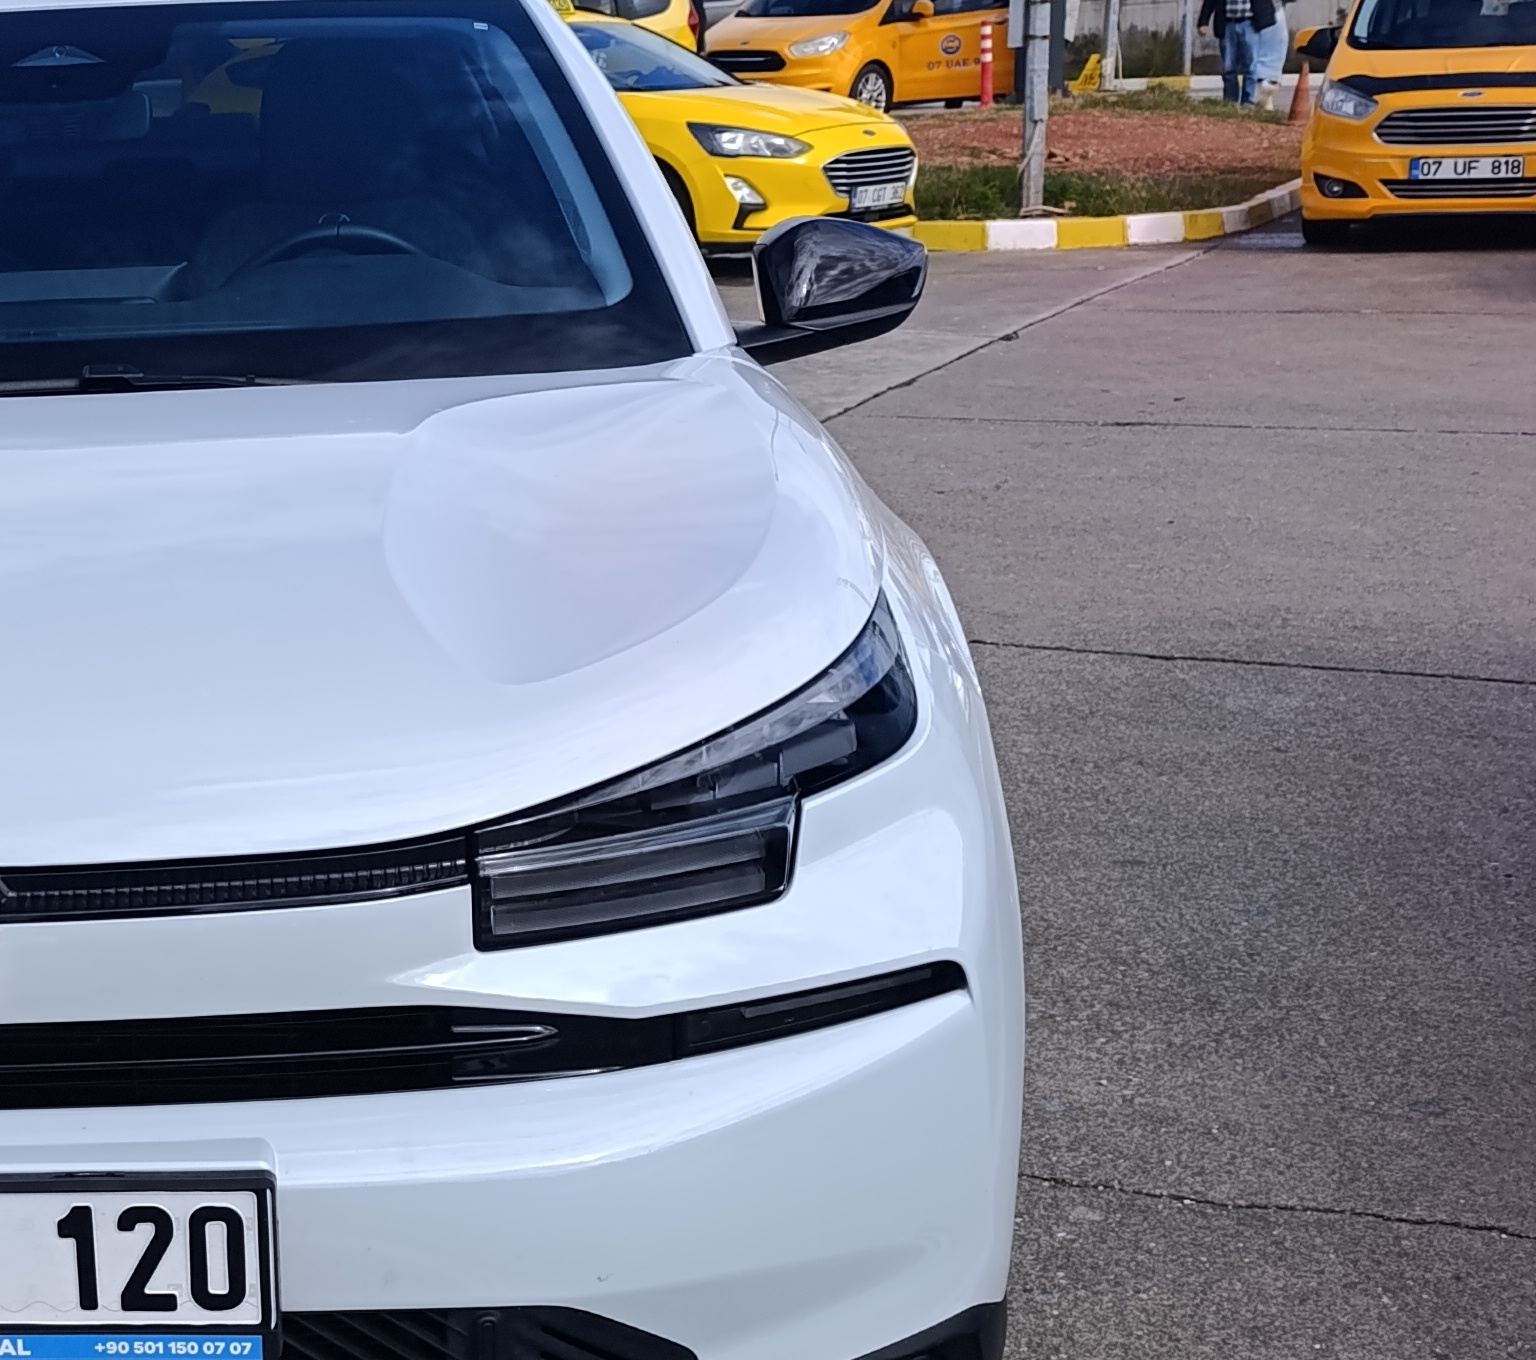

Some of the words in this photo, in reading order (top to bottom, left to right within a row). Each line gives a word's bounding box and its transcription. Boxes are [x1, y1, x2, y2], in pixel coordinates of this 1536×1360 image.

[1421, 161, 1443, 177] 07
[1453, 159, 1481, 176] UF
[1491, 159, 1522, 175] 818
[56, 1205, 247, 1313] 120
[94, 1341, 130, 1355] +90
[133, 1341, 165, 1355] 501
[167, 1341, 200, 1355] 150
[202, 1341, 225, 1355] 07
[229, 1341, 252, 1355] 07
